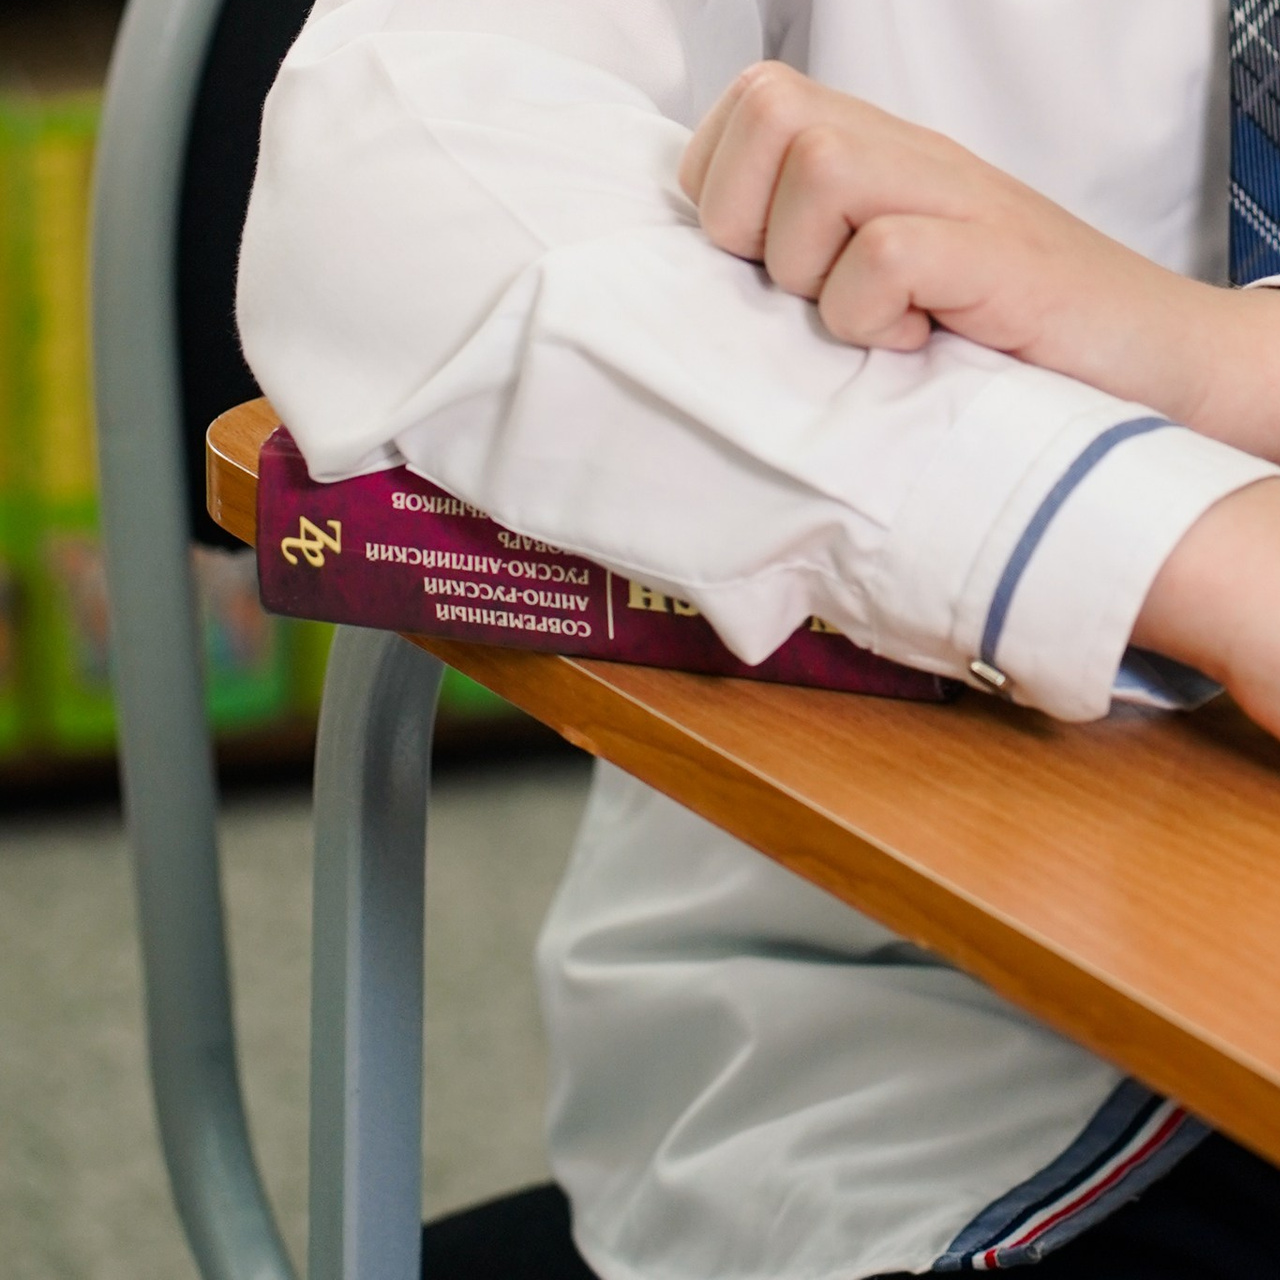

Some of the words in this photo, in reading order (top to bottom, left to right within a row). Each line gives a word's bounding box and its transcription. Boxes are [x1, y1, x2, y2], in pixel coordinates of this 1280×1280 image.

[365, 542, 589, 586] РУССКО-АНГЛИЙСКИЙ
[423, 576, 589, 612] АНГЛО-РУССКИЙ
[435, 603, 592, 638] СОВРЕМЕННЫЙ
